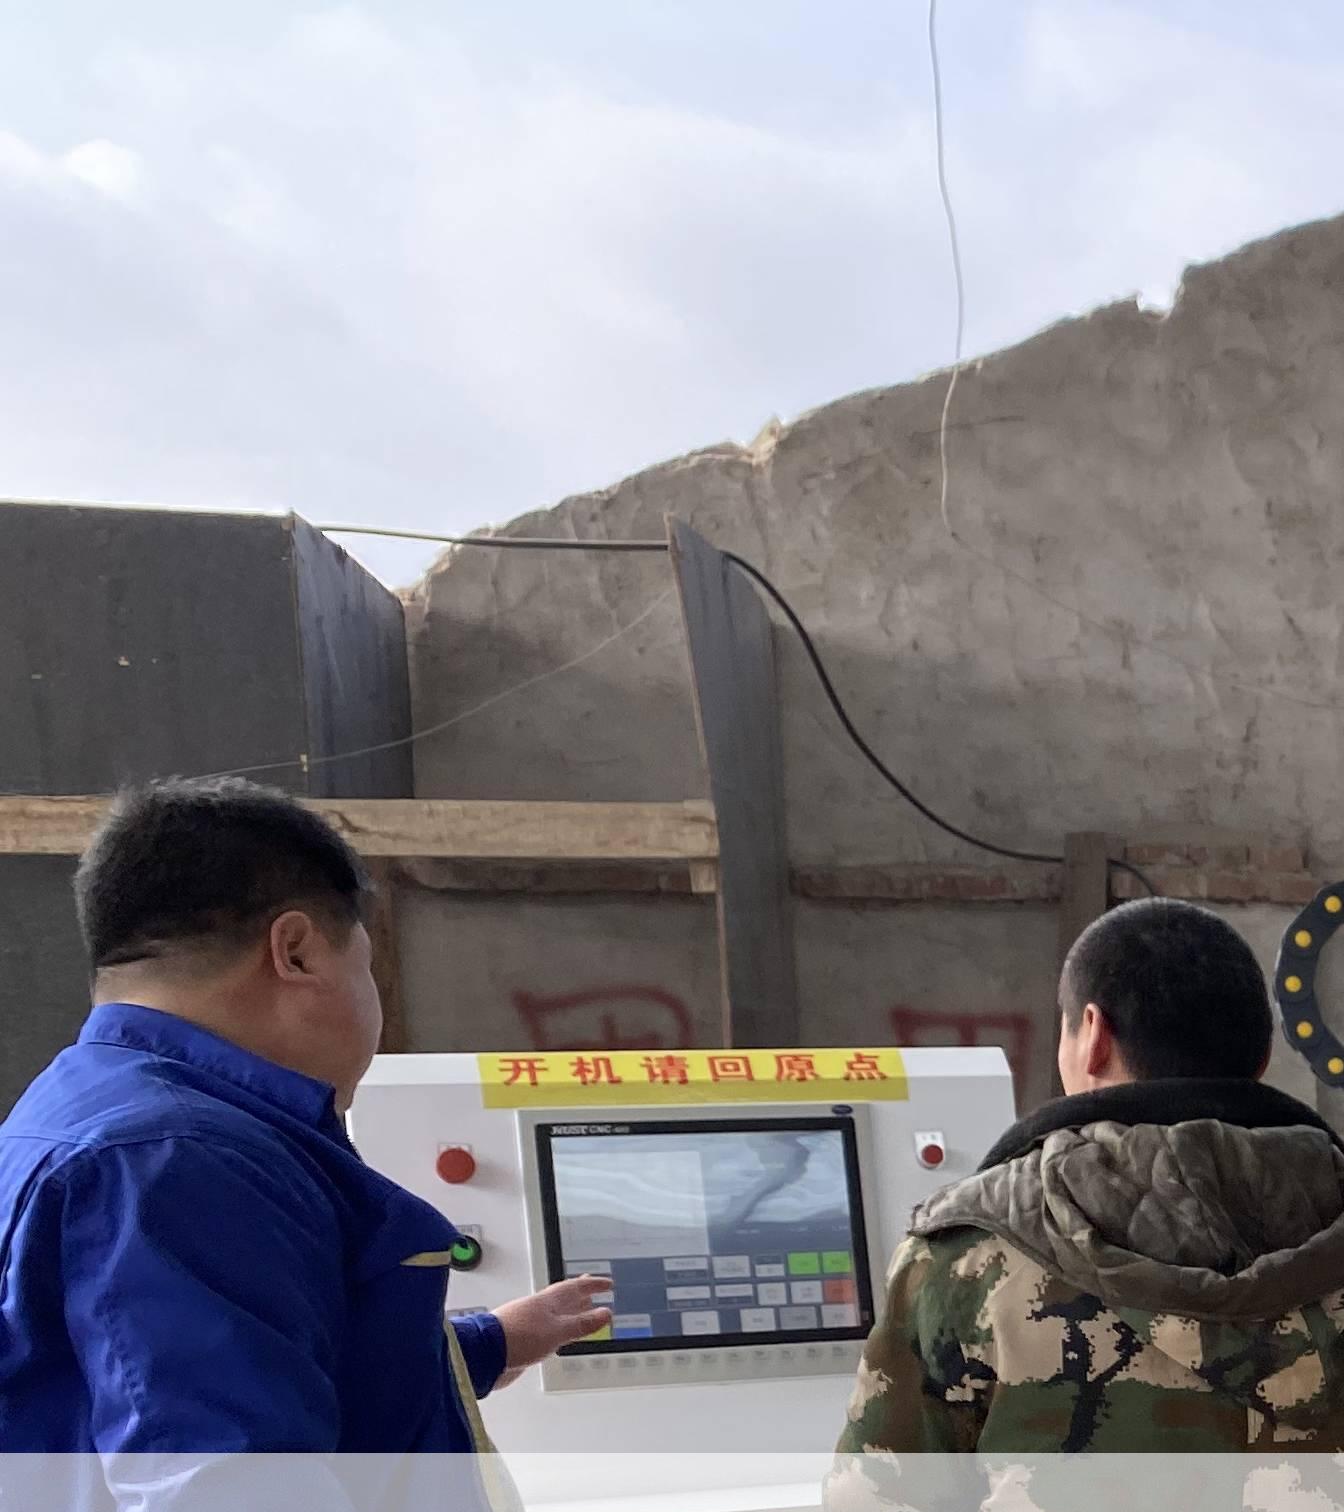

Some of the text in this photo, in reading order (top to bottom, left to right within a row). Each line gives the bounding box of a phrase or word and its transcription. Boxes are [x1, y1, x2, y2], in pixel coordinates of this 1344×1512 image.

[499, 1053, 888, 1086] 开机请回原点
